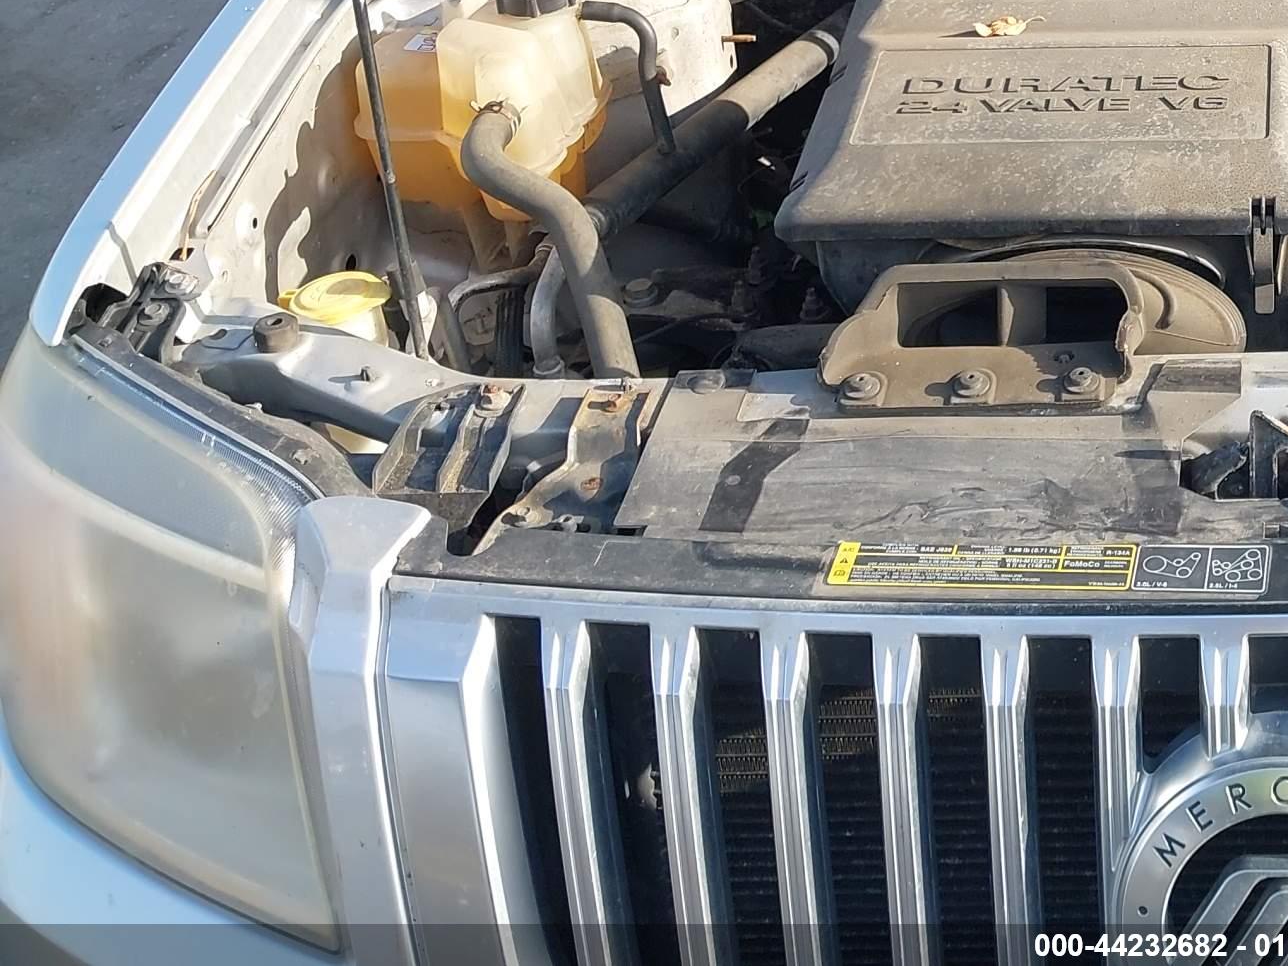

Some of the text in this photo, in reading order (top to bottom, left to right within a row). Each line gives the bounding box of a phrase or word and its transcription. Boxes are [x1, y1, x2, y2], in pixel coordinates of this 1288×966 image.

[902, 74, 1230, 95] DURATEC
[896, 100, 968, 115] 24
[980, 97, 1131, 113] VALVE
[1064, 560, 1100, 568] FoMoCo
